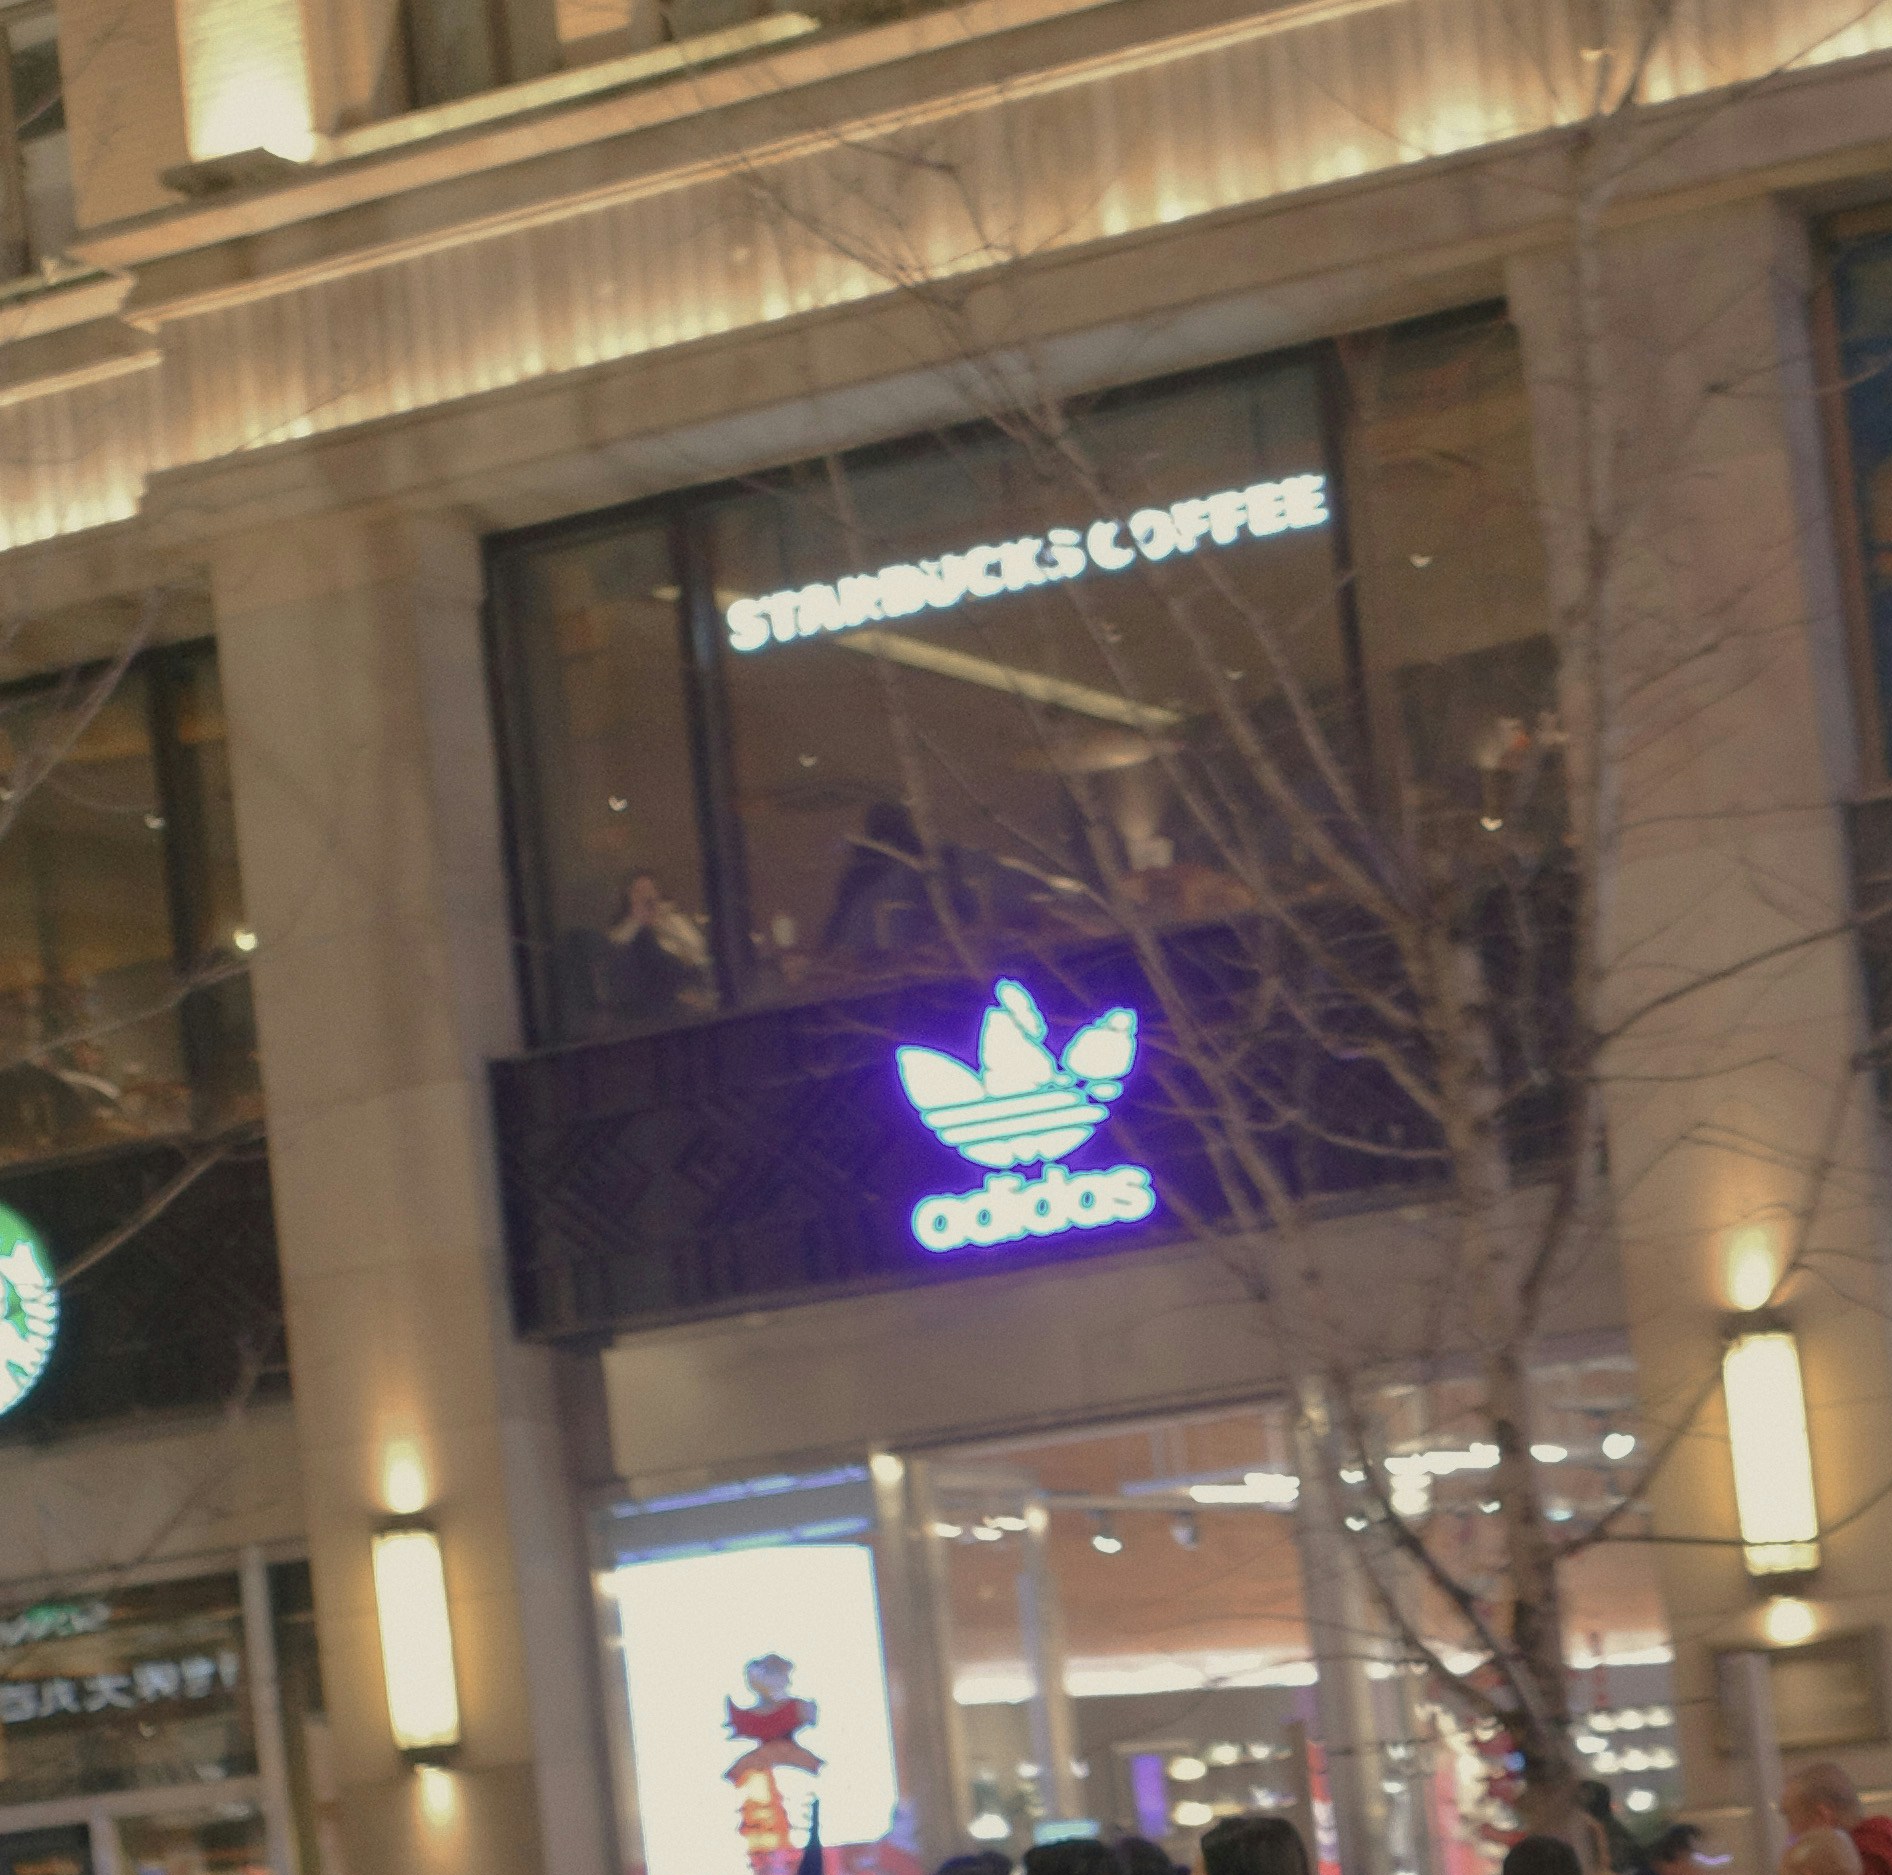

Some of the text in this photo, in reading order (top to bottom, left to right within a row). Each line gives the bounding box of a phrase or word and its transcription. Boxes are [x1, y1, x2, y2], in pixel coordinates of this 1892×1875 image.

[726, 474, 1329, 651] STARBUCKS COFFEE
[912, 1162, 1156, 1252] adidas
